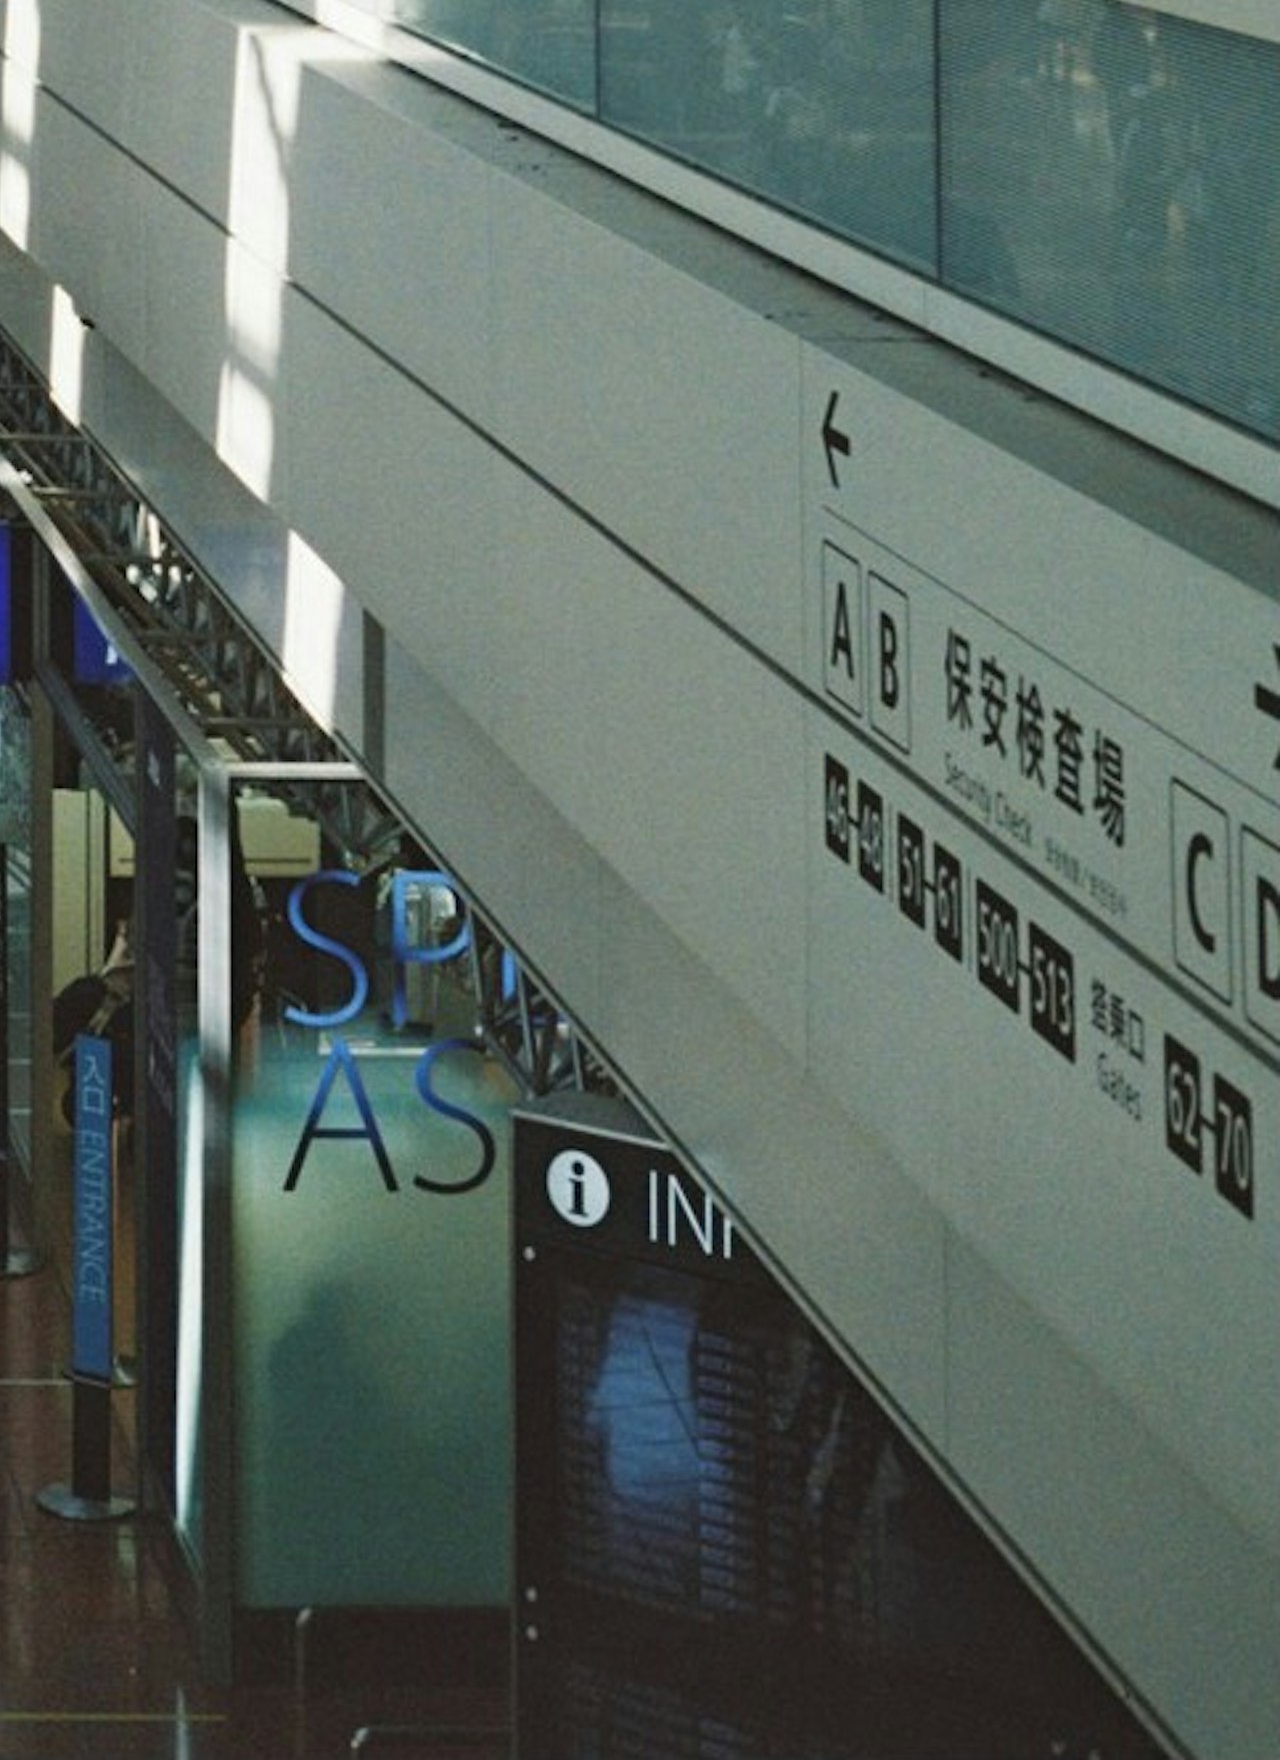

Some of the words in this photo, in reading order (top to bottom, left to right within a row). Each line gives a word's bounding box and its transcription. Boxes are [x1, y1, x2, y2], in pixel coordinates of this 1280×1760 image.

[831, 580, 854, 679] A
[880, 611, 900, 709] B
[944, 627, 1125, 847] 保安検査場
[1186, 832, 1216, 954] C
[82, 1055, 105, 1116] 入口
[283, 1036, 496, 1194] AS
[80, 1132, 108, 1302] ENTRANCE
